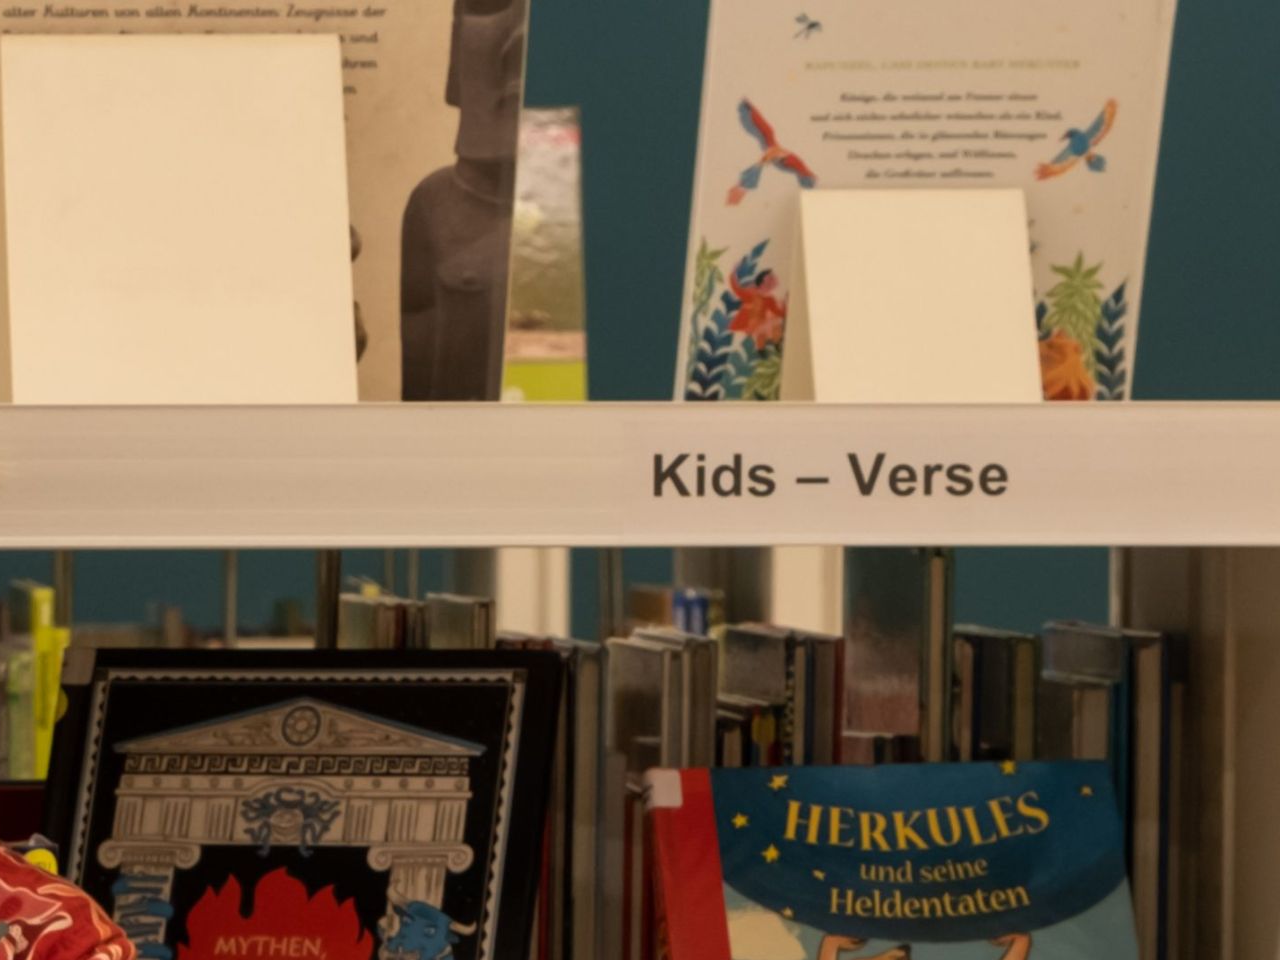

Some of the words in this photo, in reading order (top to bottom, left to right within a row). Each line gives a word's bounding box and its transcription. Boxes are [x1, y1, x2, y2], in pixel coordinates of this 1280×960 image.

[43, 5, 109, 18] Kulturen
[114, 9, 141, 18] von
[363, 6, 387, 18] der
[653, 452, 777, 498] Kids
[847, 452, 1009, 498] Verse
[784, 789, 1050, 853] HERKULES
[859, 859, 913, 884] und
[919, 857, 988, 884] seine
[829, 885, 1031, 919] Heldentaten
[213, 936, 328, 960] MYTHEN,
